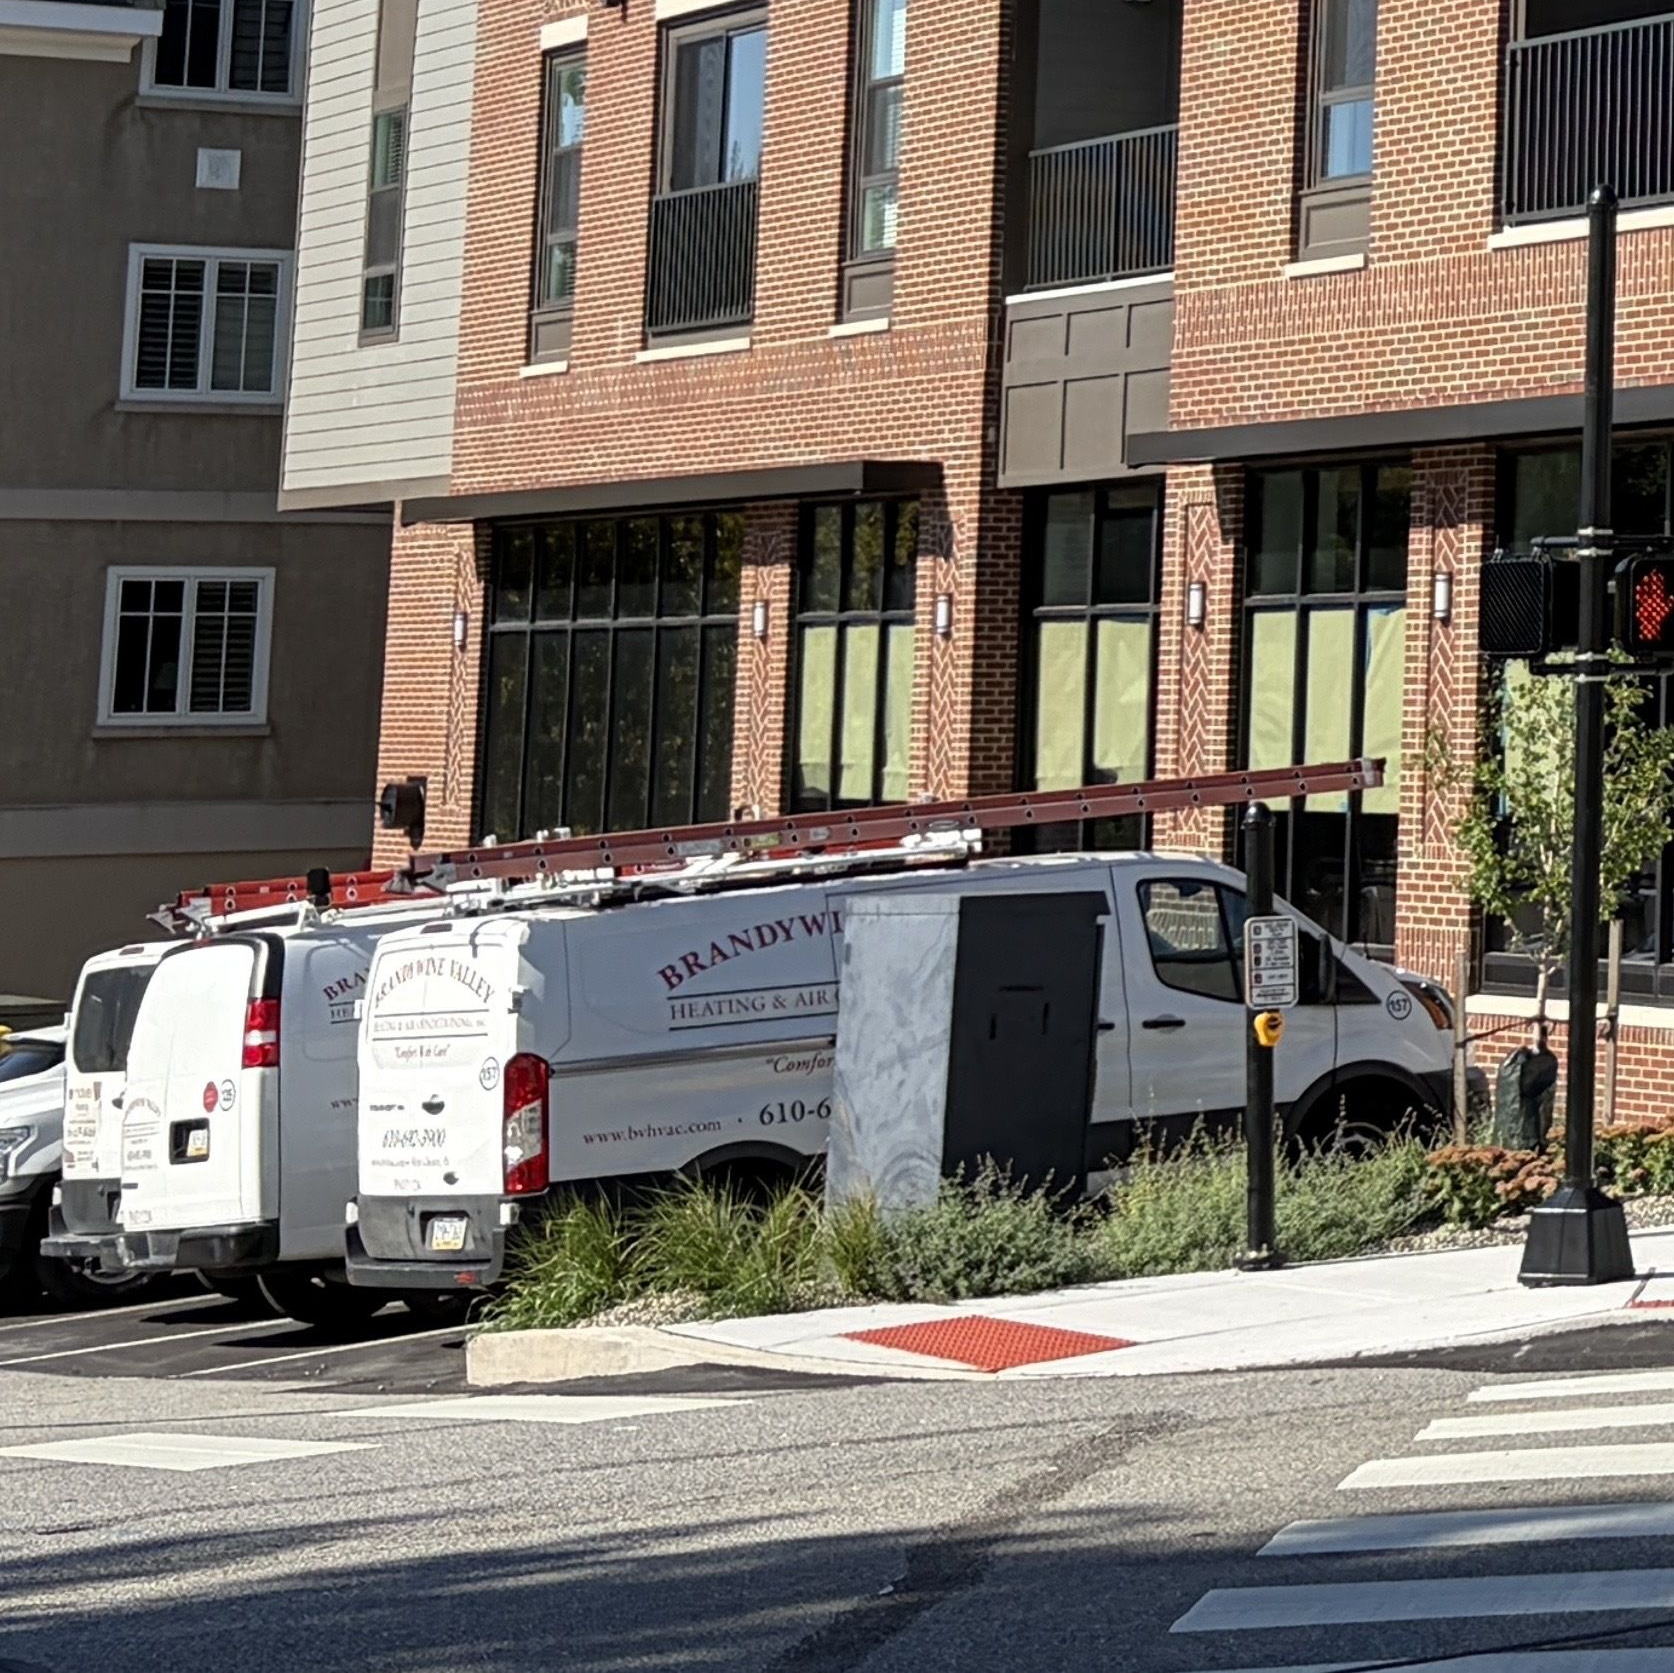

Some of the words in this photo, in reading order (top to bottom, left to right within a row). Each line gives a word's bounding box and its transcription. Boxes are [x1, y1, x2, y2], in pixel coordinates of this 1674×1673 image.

[322, 967, 369, 1001] BRA
[450, 959, 496, 1004] VALLEY
[670, 997, 766, 1021] HEATING
[772, 993, 787, 1010] &
[794, 989, 833, 1008] AIR
[583, 1120, 722, 1145] www.bvhvac.com
